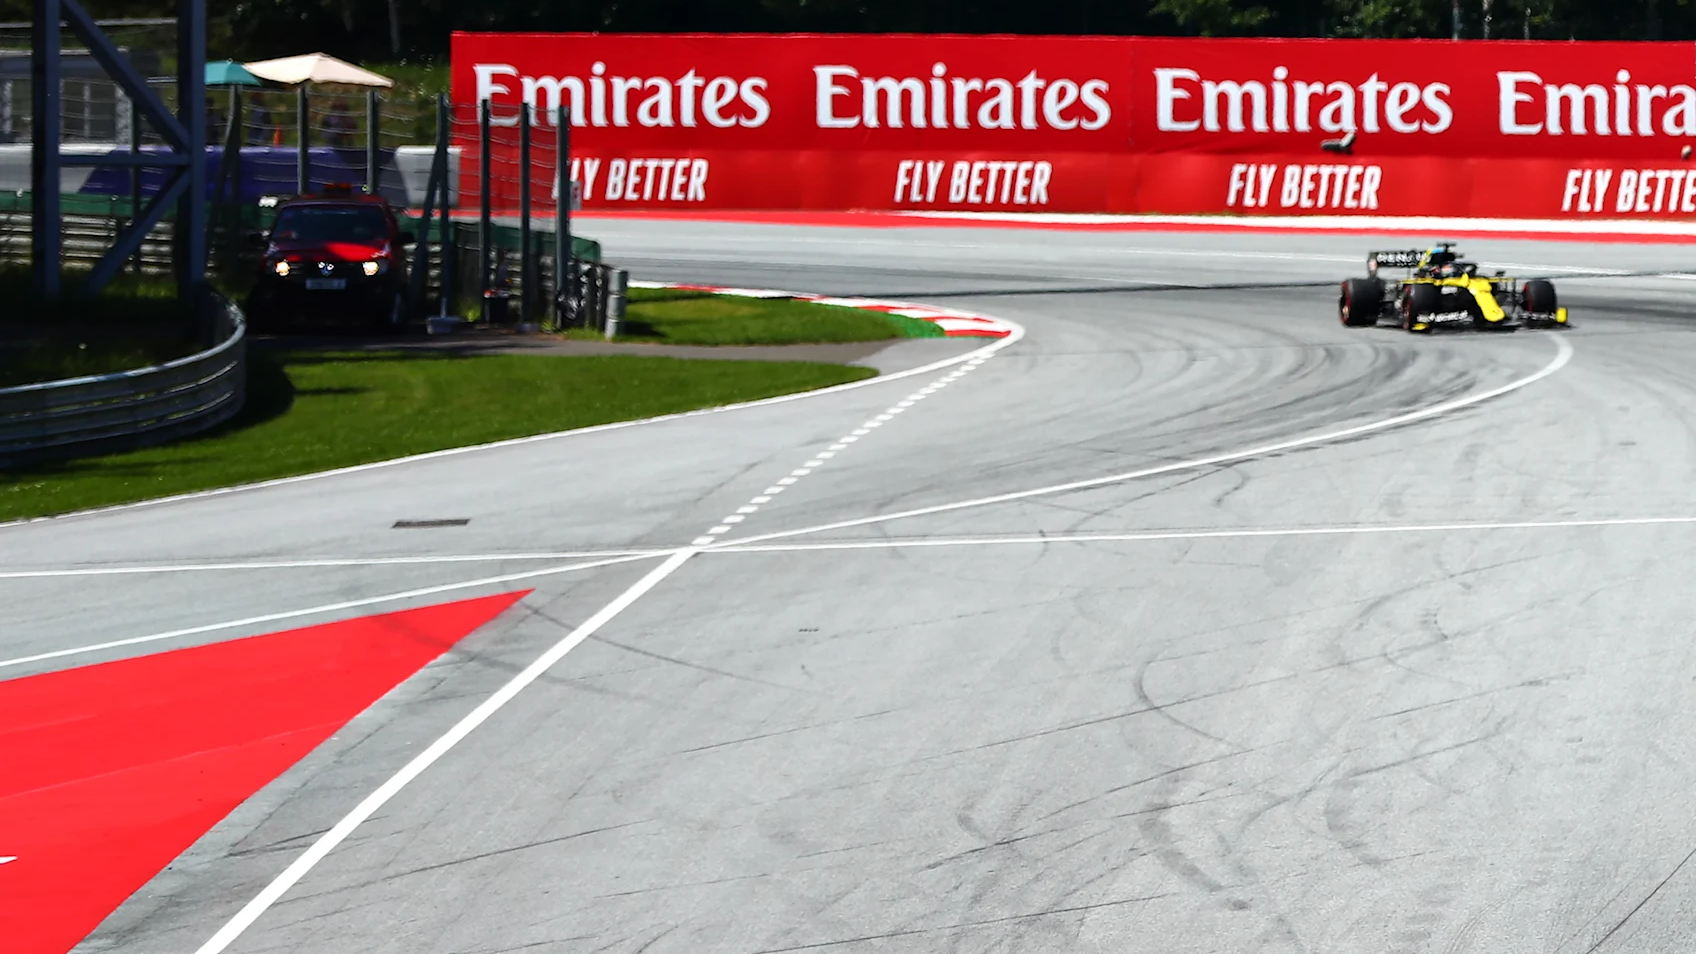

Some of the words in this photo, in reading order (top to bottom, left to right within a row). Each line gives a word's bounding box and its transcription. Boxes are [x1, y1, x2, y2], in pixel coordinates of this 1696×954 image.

[473, 61, 771, 129] Emirates
[813, 62, 1112, 130] Emirates
[1153, 65, 1454, 135] Emirates
[605, 158, 709, 203] BETTER
[895, 159, 943, 204] FLY
[948, 160, 1053, 206] BETTER
[1226, 163, 1278, 209] FLY
[1282, 164, 1383, 211] BETTER
[1561, 168, 1608, 214] FLY
